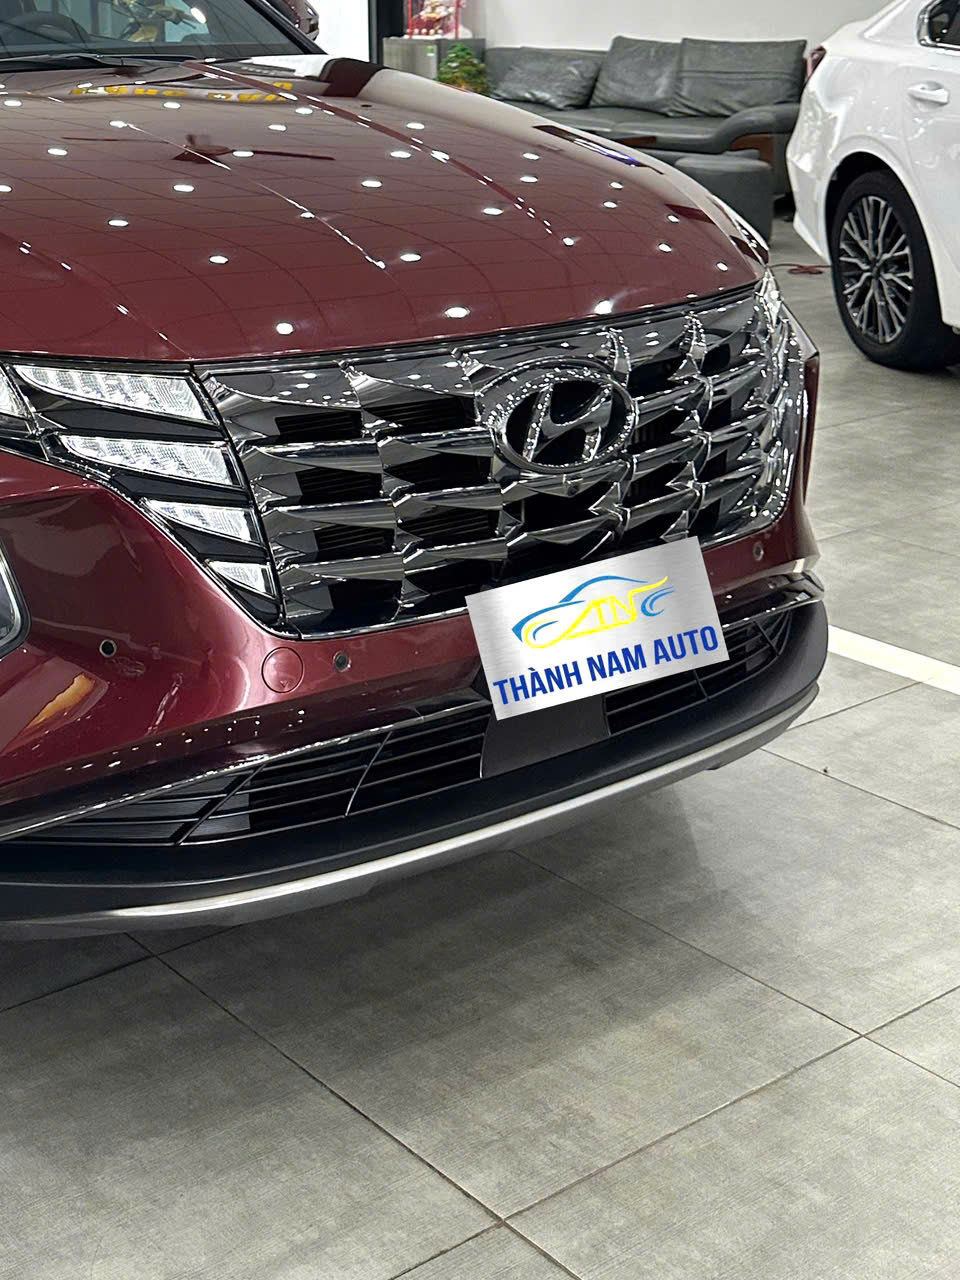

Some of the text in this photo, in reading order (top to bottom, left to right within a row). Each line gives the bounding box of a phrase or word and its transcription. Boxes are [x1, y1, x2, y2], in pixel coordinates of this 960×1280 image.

[493, 625, 719, 705] THÀNH NAM AUTO
